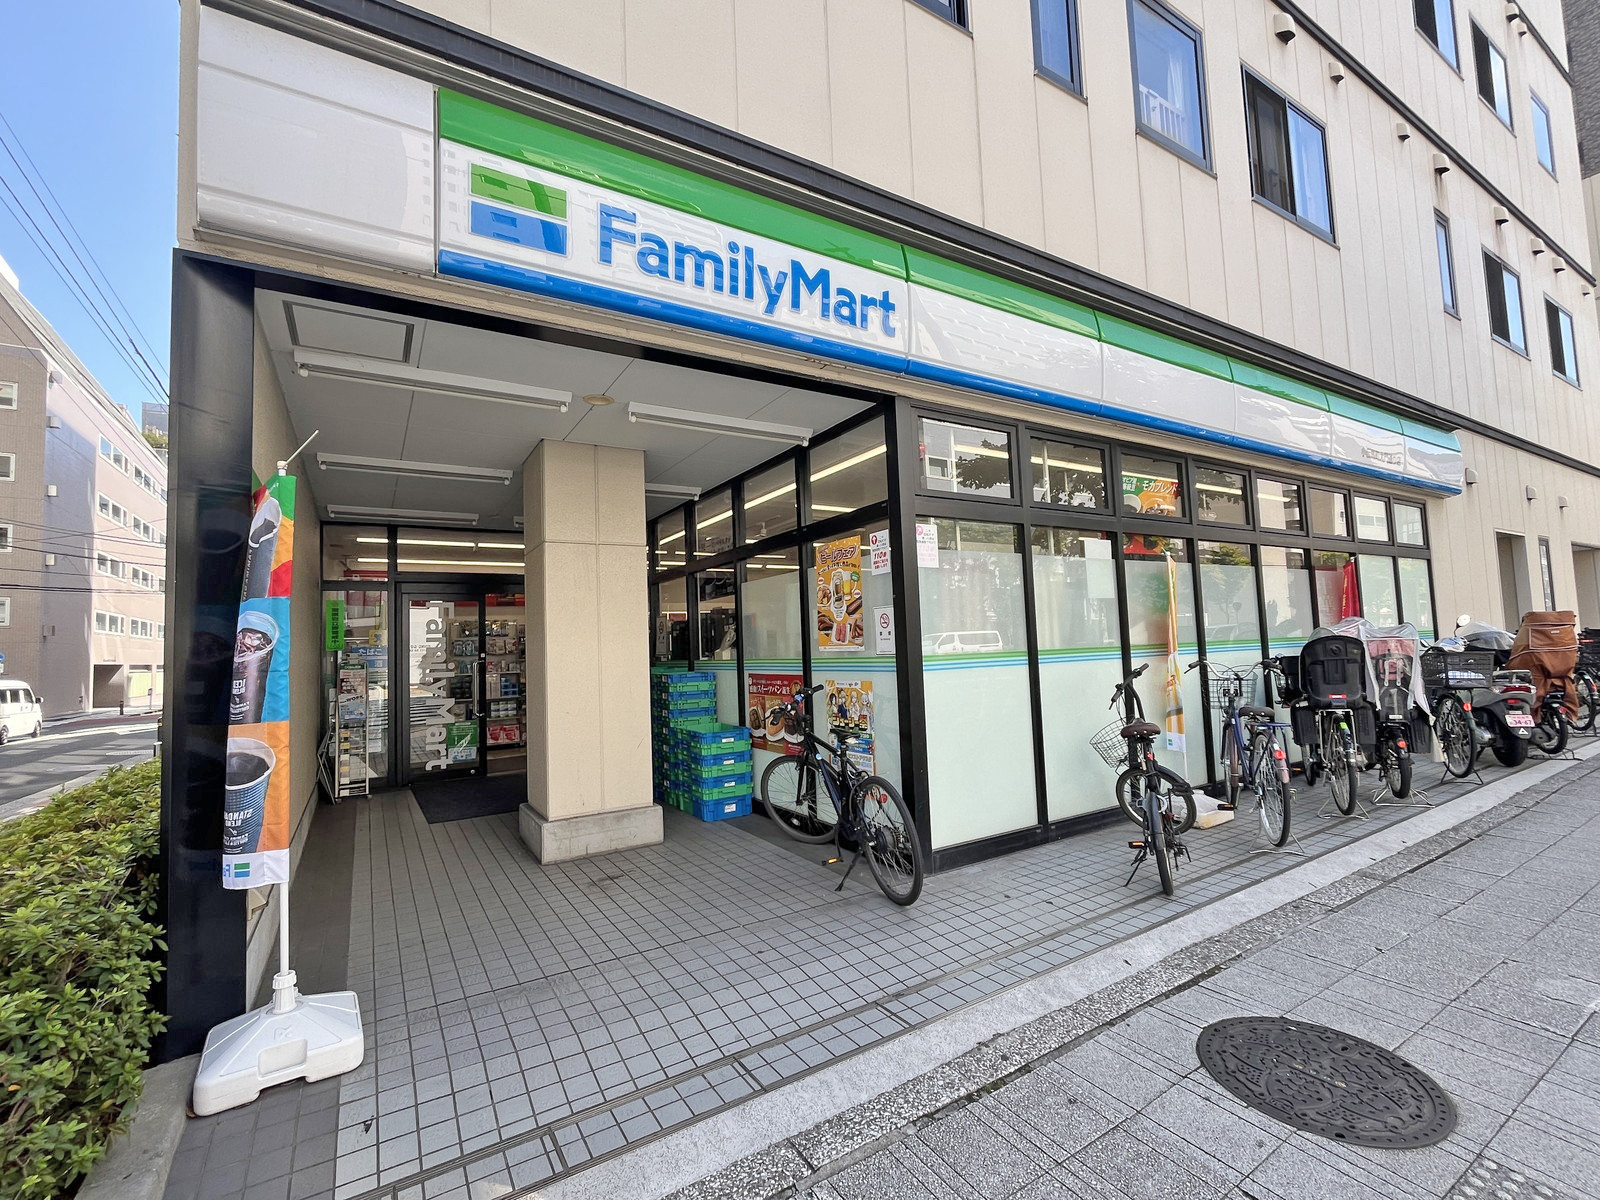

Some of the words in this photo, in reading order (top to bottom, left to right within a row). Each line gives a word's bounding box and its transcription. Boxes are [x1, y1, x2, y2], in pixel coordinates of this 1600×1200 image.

[599, 203, 896, 335] FamilyMart
[1142, 480, 1178, 494] モカブレンド
[359, 648, 383, 656] たばこ
[417, 600, 456, 771] FamilyMart
